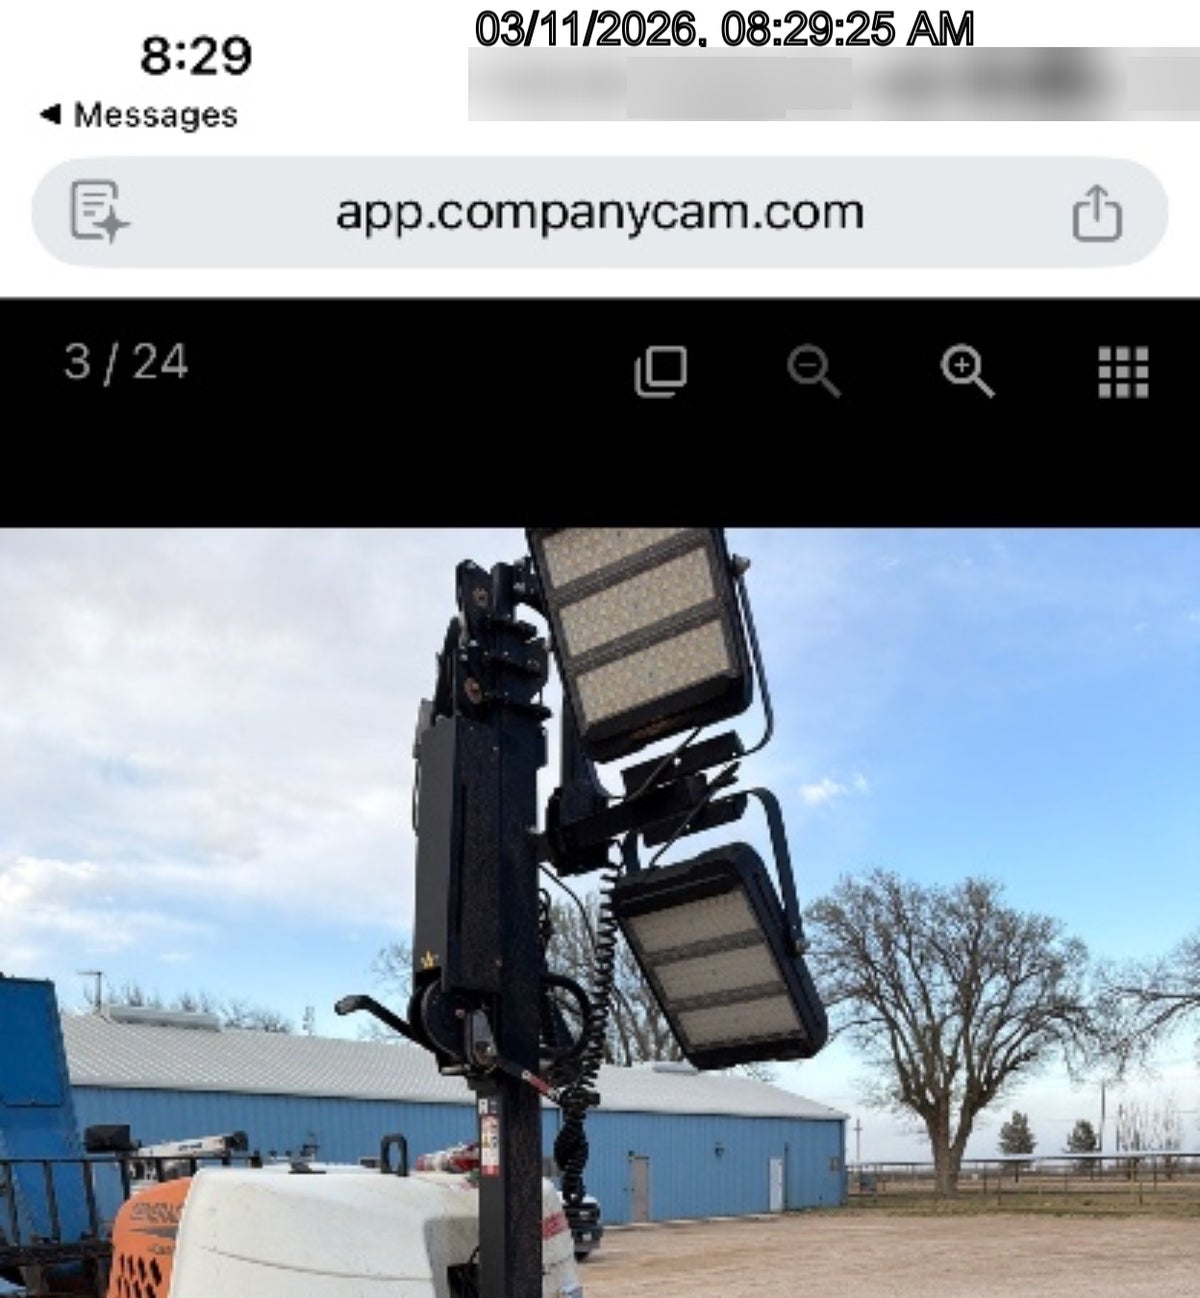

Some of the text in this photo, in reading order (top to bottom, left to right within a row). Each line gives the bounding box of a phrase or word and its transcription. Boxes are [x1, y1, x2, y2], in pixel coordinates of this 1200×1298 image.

[140, 35, 252, 76] 8:29
[74, 101, 238, 134] Messages
[336, 192, 864, 239] app.companycam.com
[64, 342, 91, 380] 3
[133, 342, 189, 379] 24
